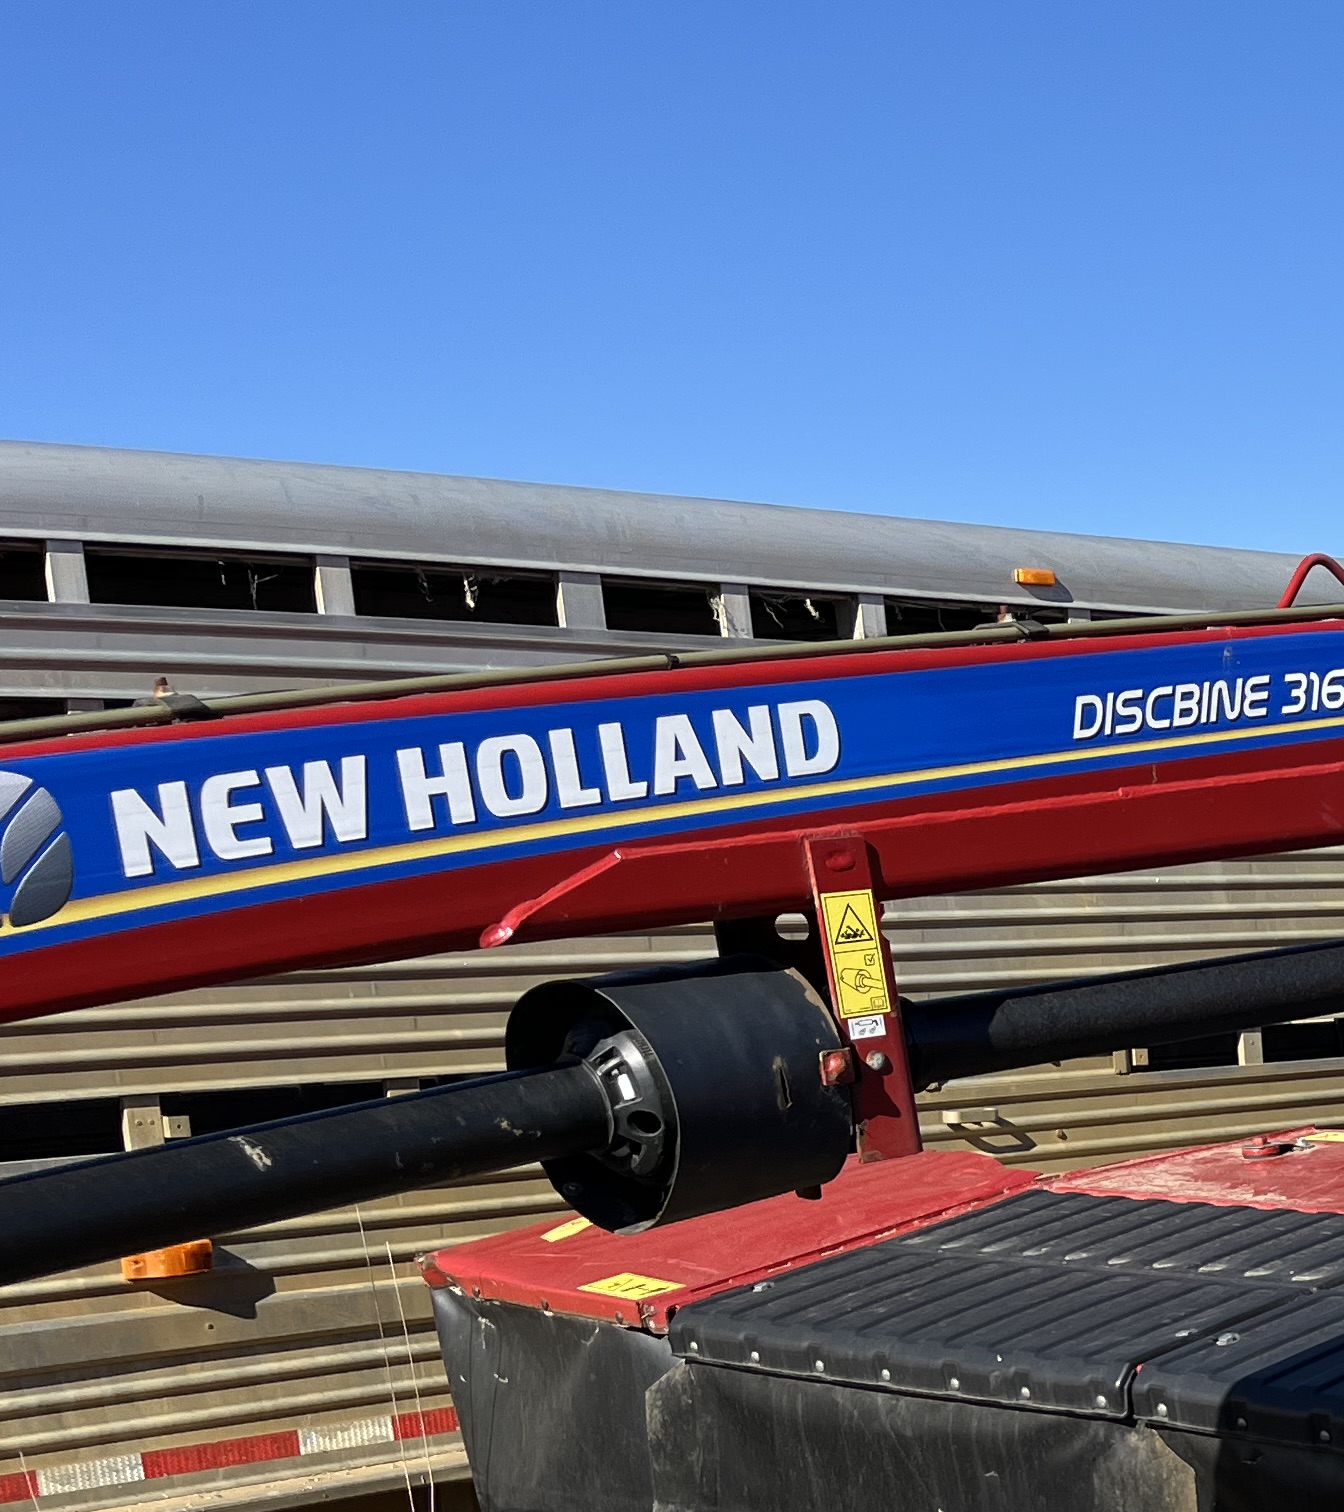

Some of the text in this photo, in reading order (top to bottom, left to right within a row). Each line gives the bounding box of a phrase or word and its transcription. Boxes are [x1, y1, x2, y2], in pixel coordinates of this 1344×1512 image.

[1073, 674, 1271, 740] DISCBINE
[110, 699, 841, 878] NEW HOLLAND
